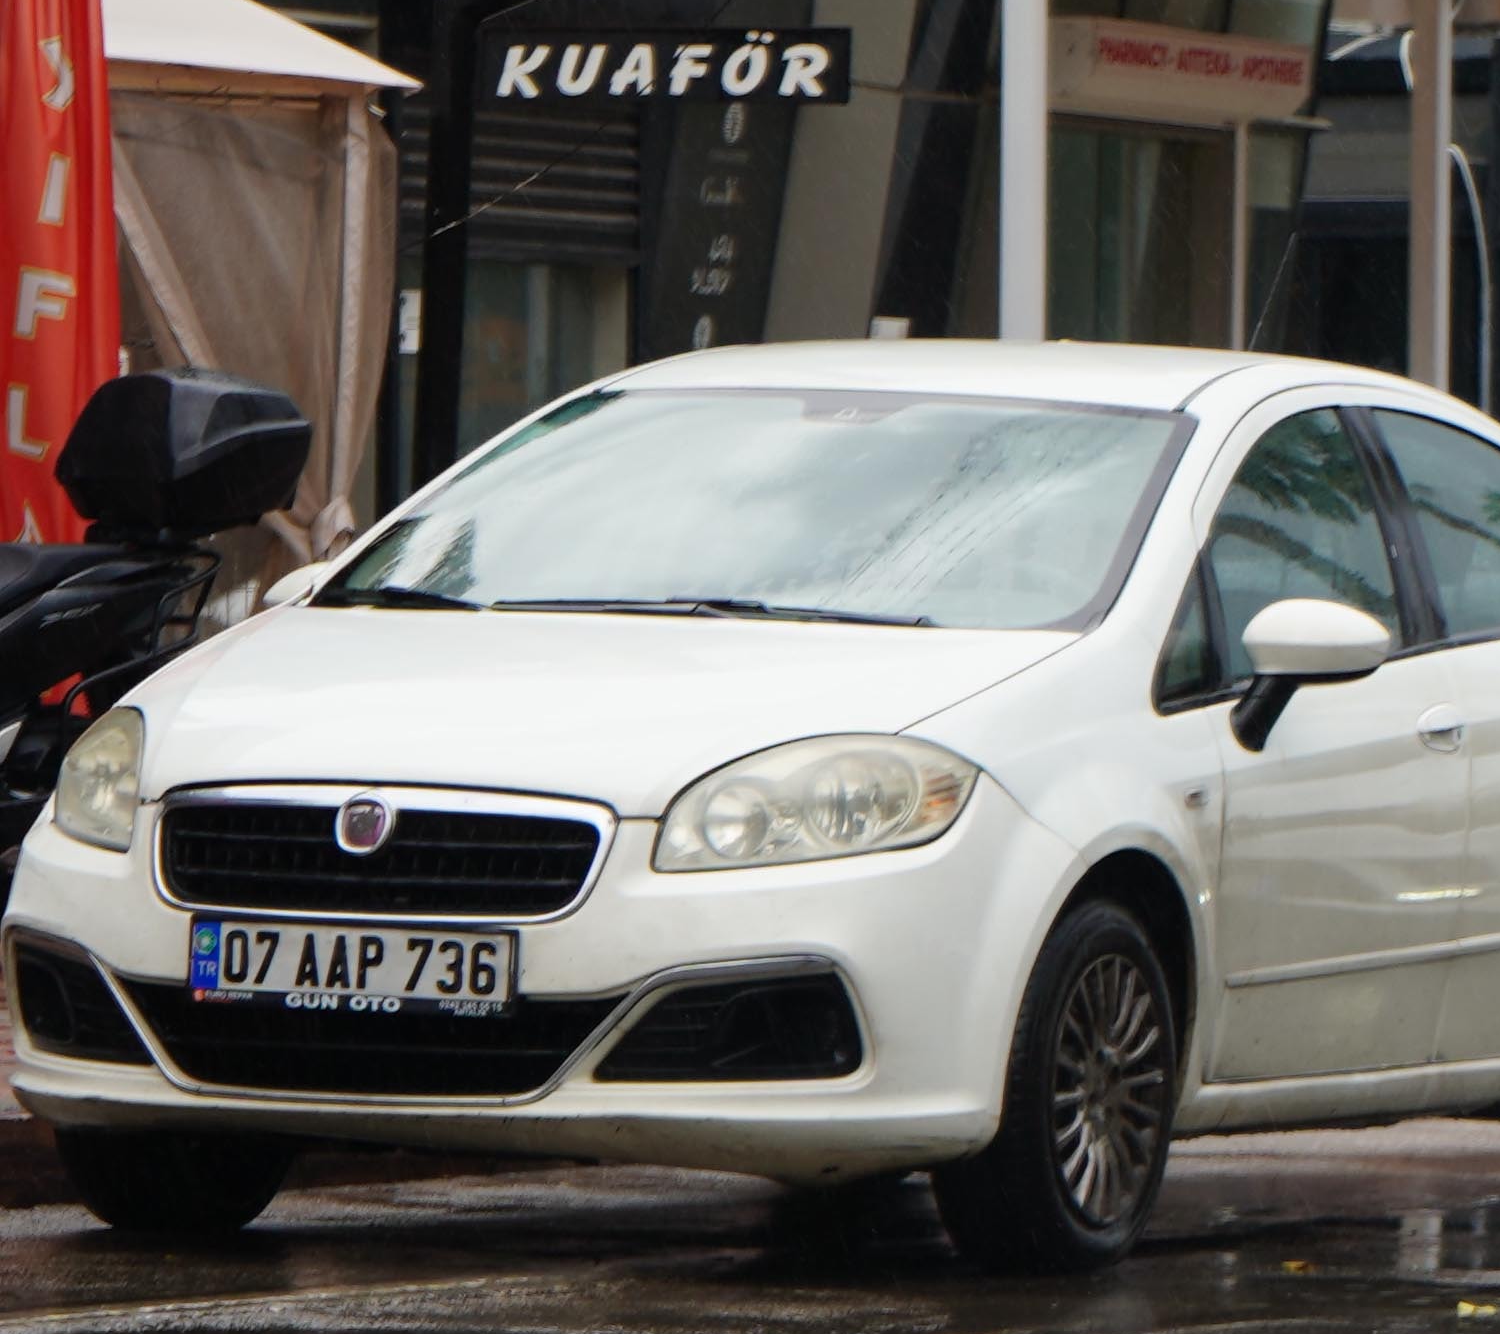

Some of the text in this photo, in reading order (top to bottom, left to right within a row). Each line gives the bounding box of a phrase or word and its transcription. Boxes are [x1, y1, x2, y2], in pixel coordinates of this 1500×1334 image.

[496, 30, 830, 99] KUAFÖR
[197, 960, 217, 978] TR
[223, 929, 498, 996] 07 AAP 736
[349, 996, 401, 1013] OTO
